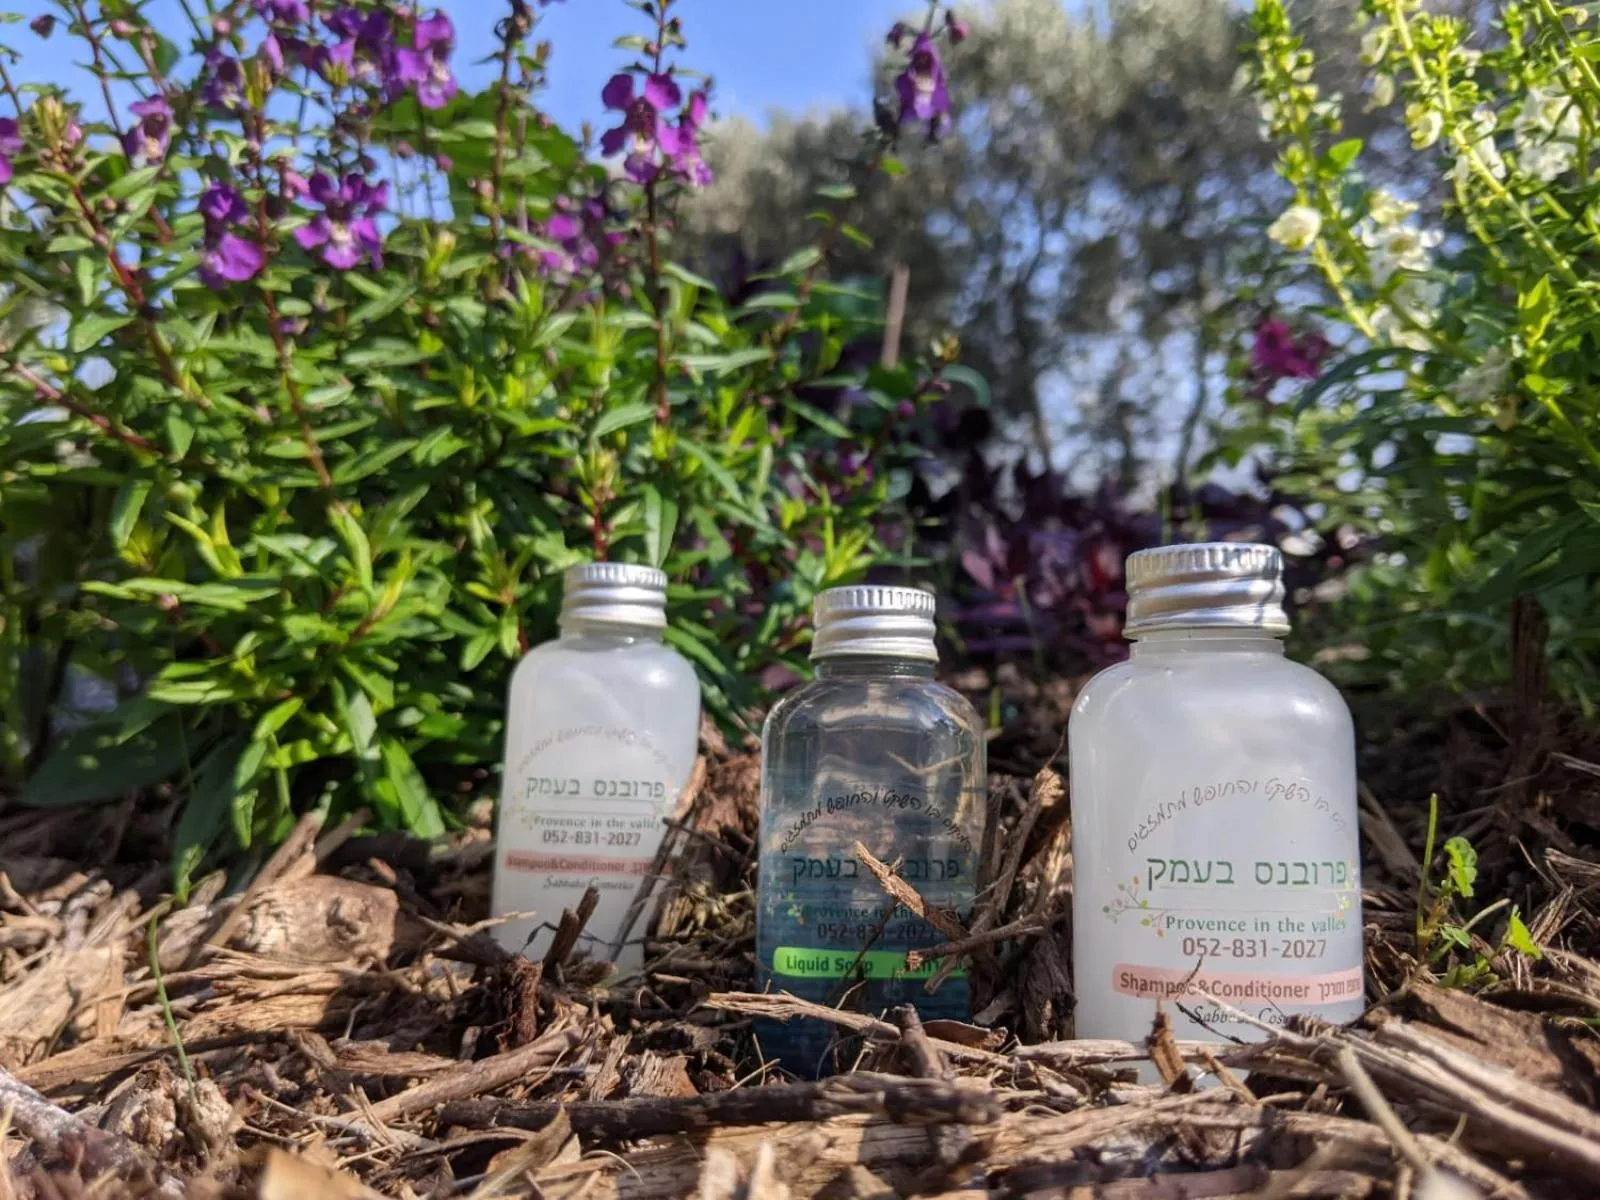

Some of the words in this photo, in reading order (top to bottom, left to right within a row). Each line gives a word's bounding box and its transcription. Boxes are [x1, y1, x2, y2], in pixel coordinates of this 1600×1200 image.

[526, 776, 580, 798] בעמק
[591, 816, 604, 828] in
[543, 830, 641, 845] 052-831-2027
[793, 858, 859, 886] בעמק
[884, 859, 960, 879] פרוב
[1147, 858, 1234, 891] בעמק
[1254, 861, 1346, 885] פרובנס
[1165, 916, 1246, 932] Provence
[1254, 916, 1270, 932] in
[1278, 917, 1305, 932] the
[1311, 916, 1347, 934] valley
[1182, 937, 1327, 958] 052-831-2027
[786, 956, 829, 973] Liquid
[835, 957, 873, 973] Sop
